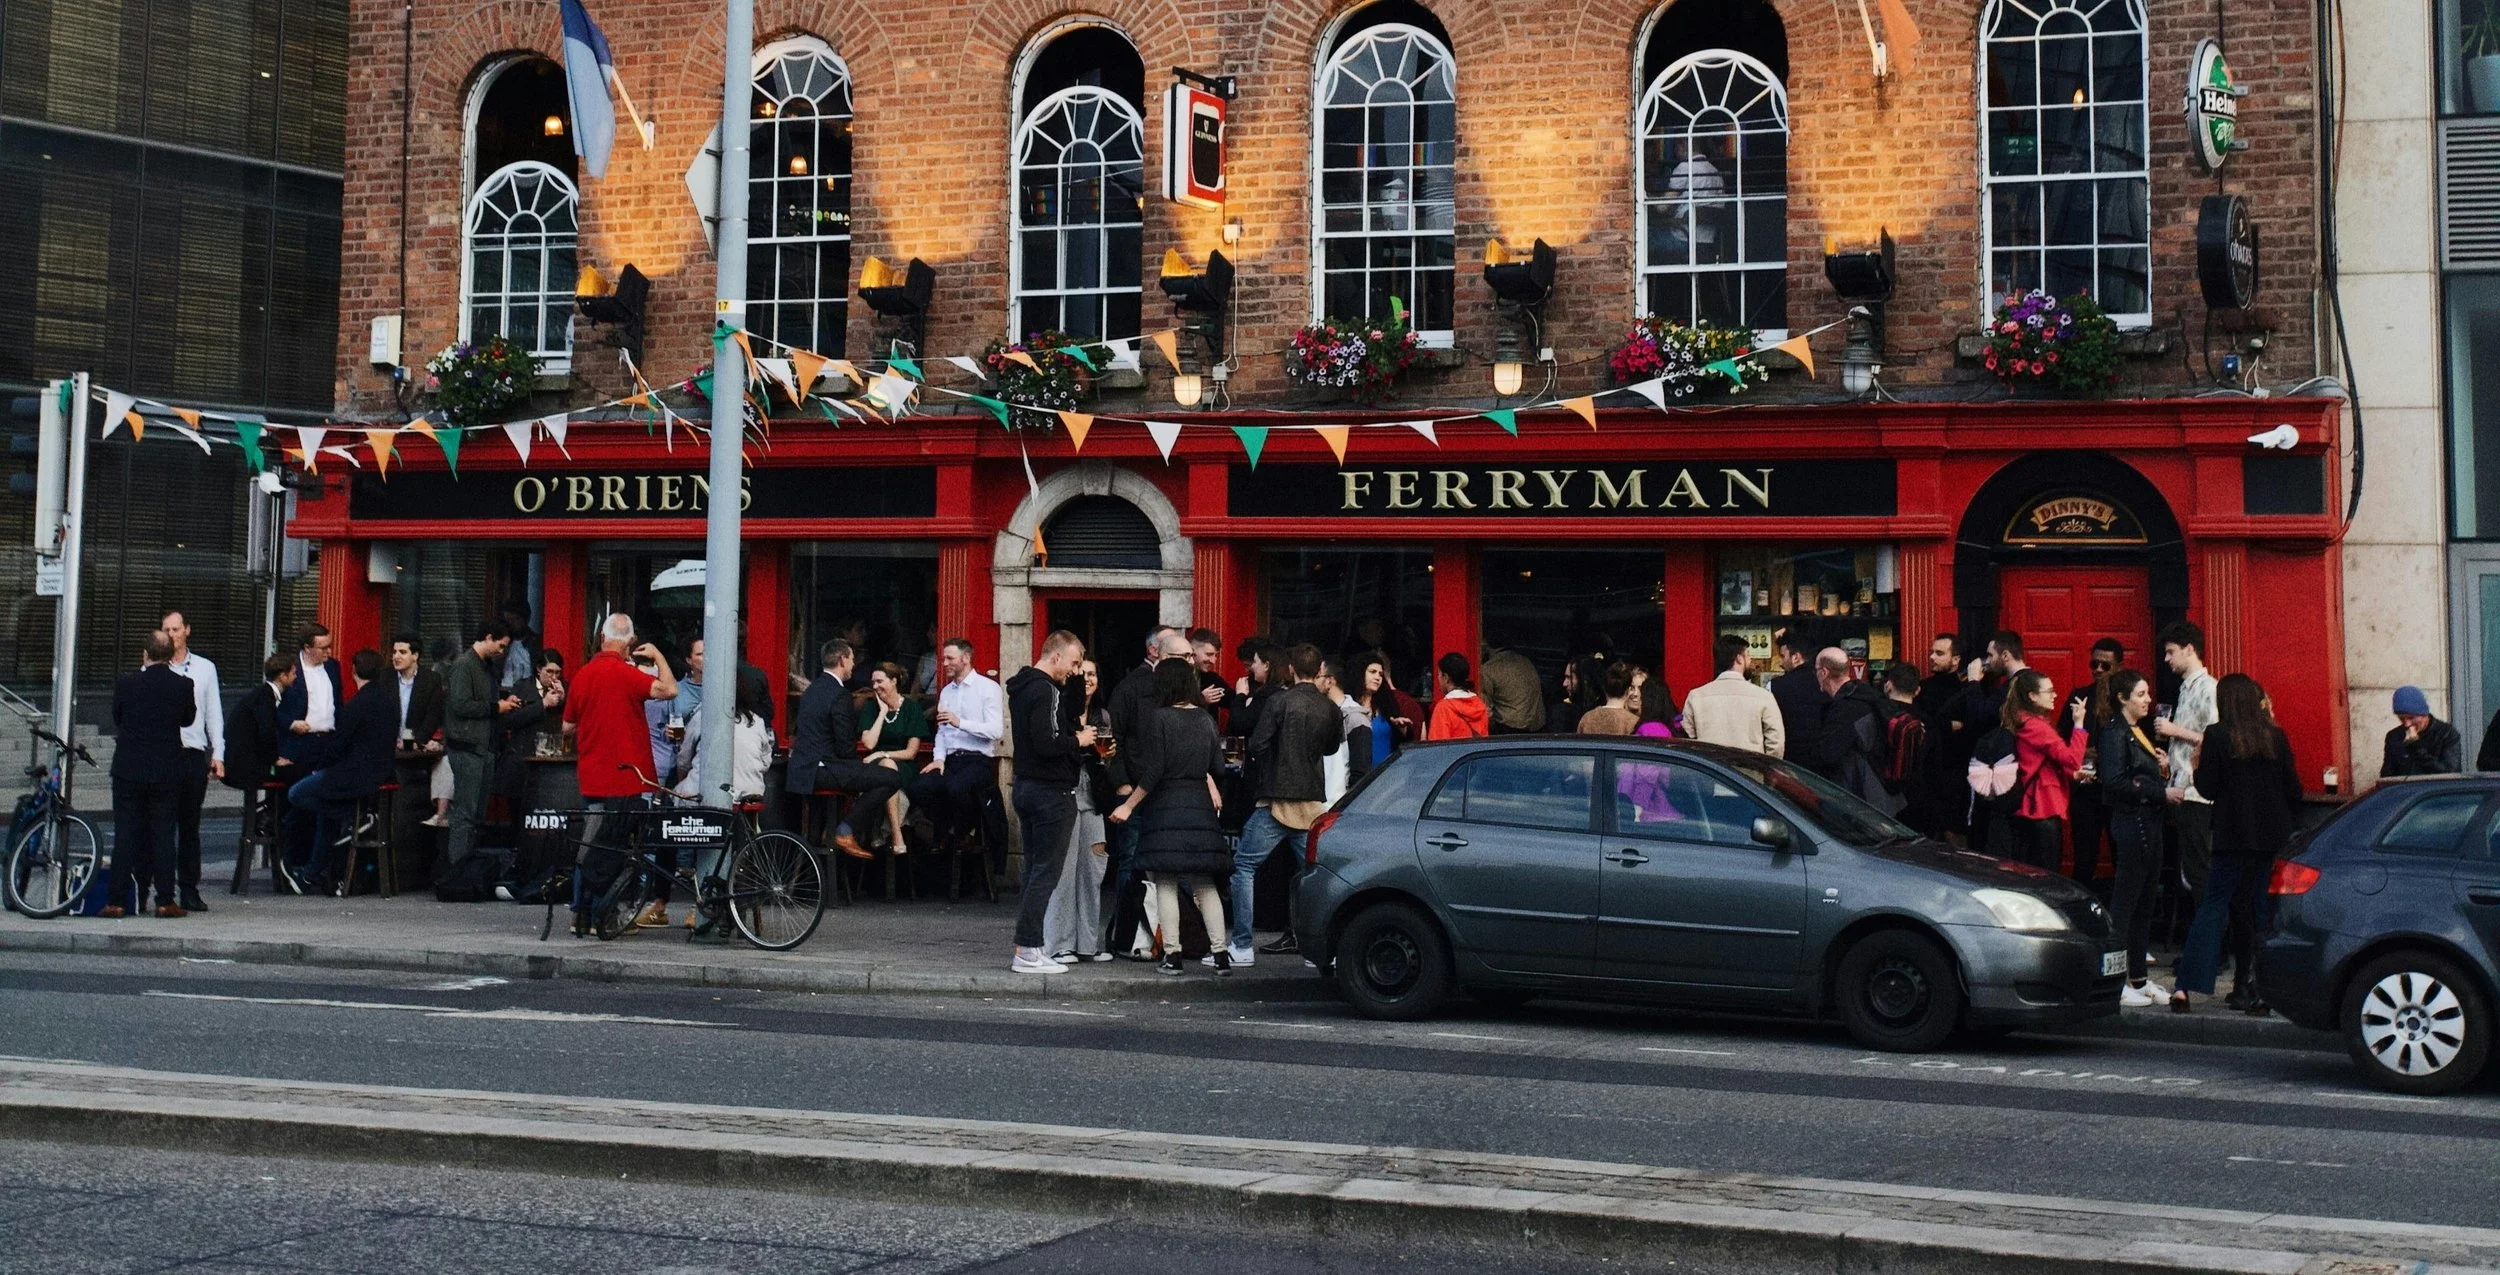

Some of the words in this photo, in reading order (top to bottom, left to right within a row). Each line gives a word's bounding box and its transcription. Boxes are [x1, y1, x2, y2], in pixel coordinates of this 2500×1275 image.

[718, 302, 728, 311] 17
[1338, 468, 1774, 510] FERRYMAN
[2040, 501, 2105, 520] DINNY'S
[525, 815, 568, 829] PADDY
[681, 815, 704, 826] the
[1852, 1057, 2202, 1086] LOADING
